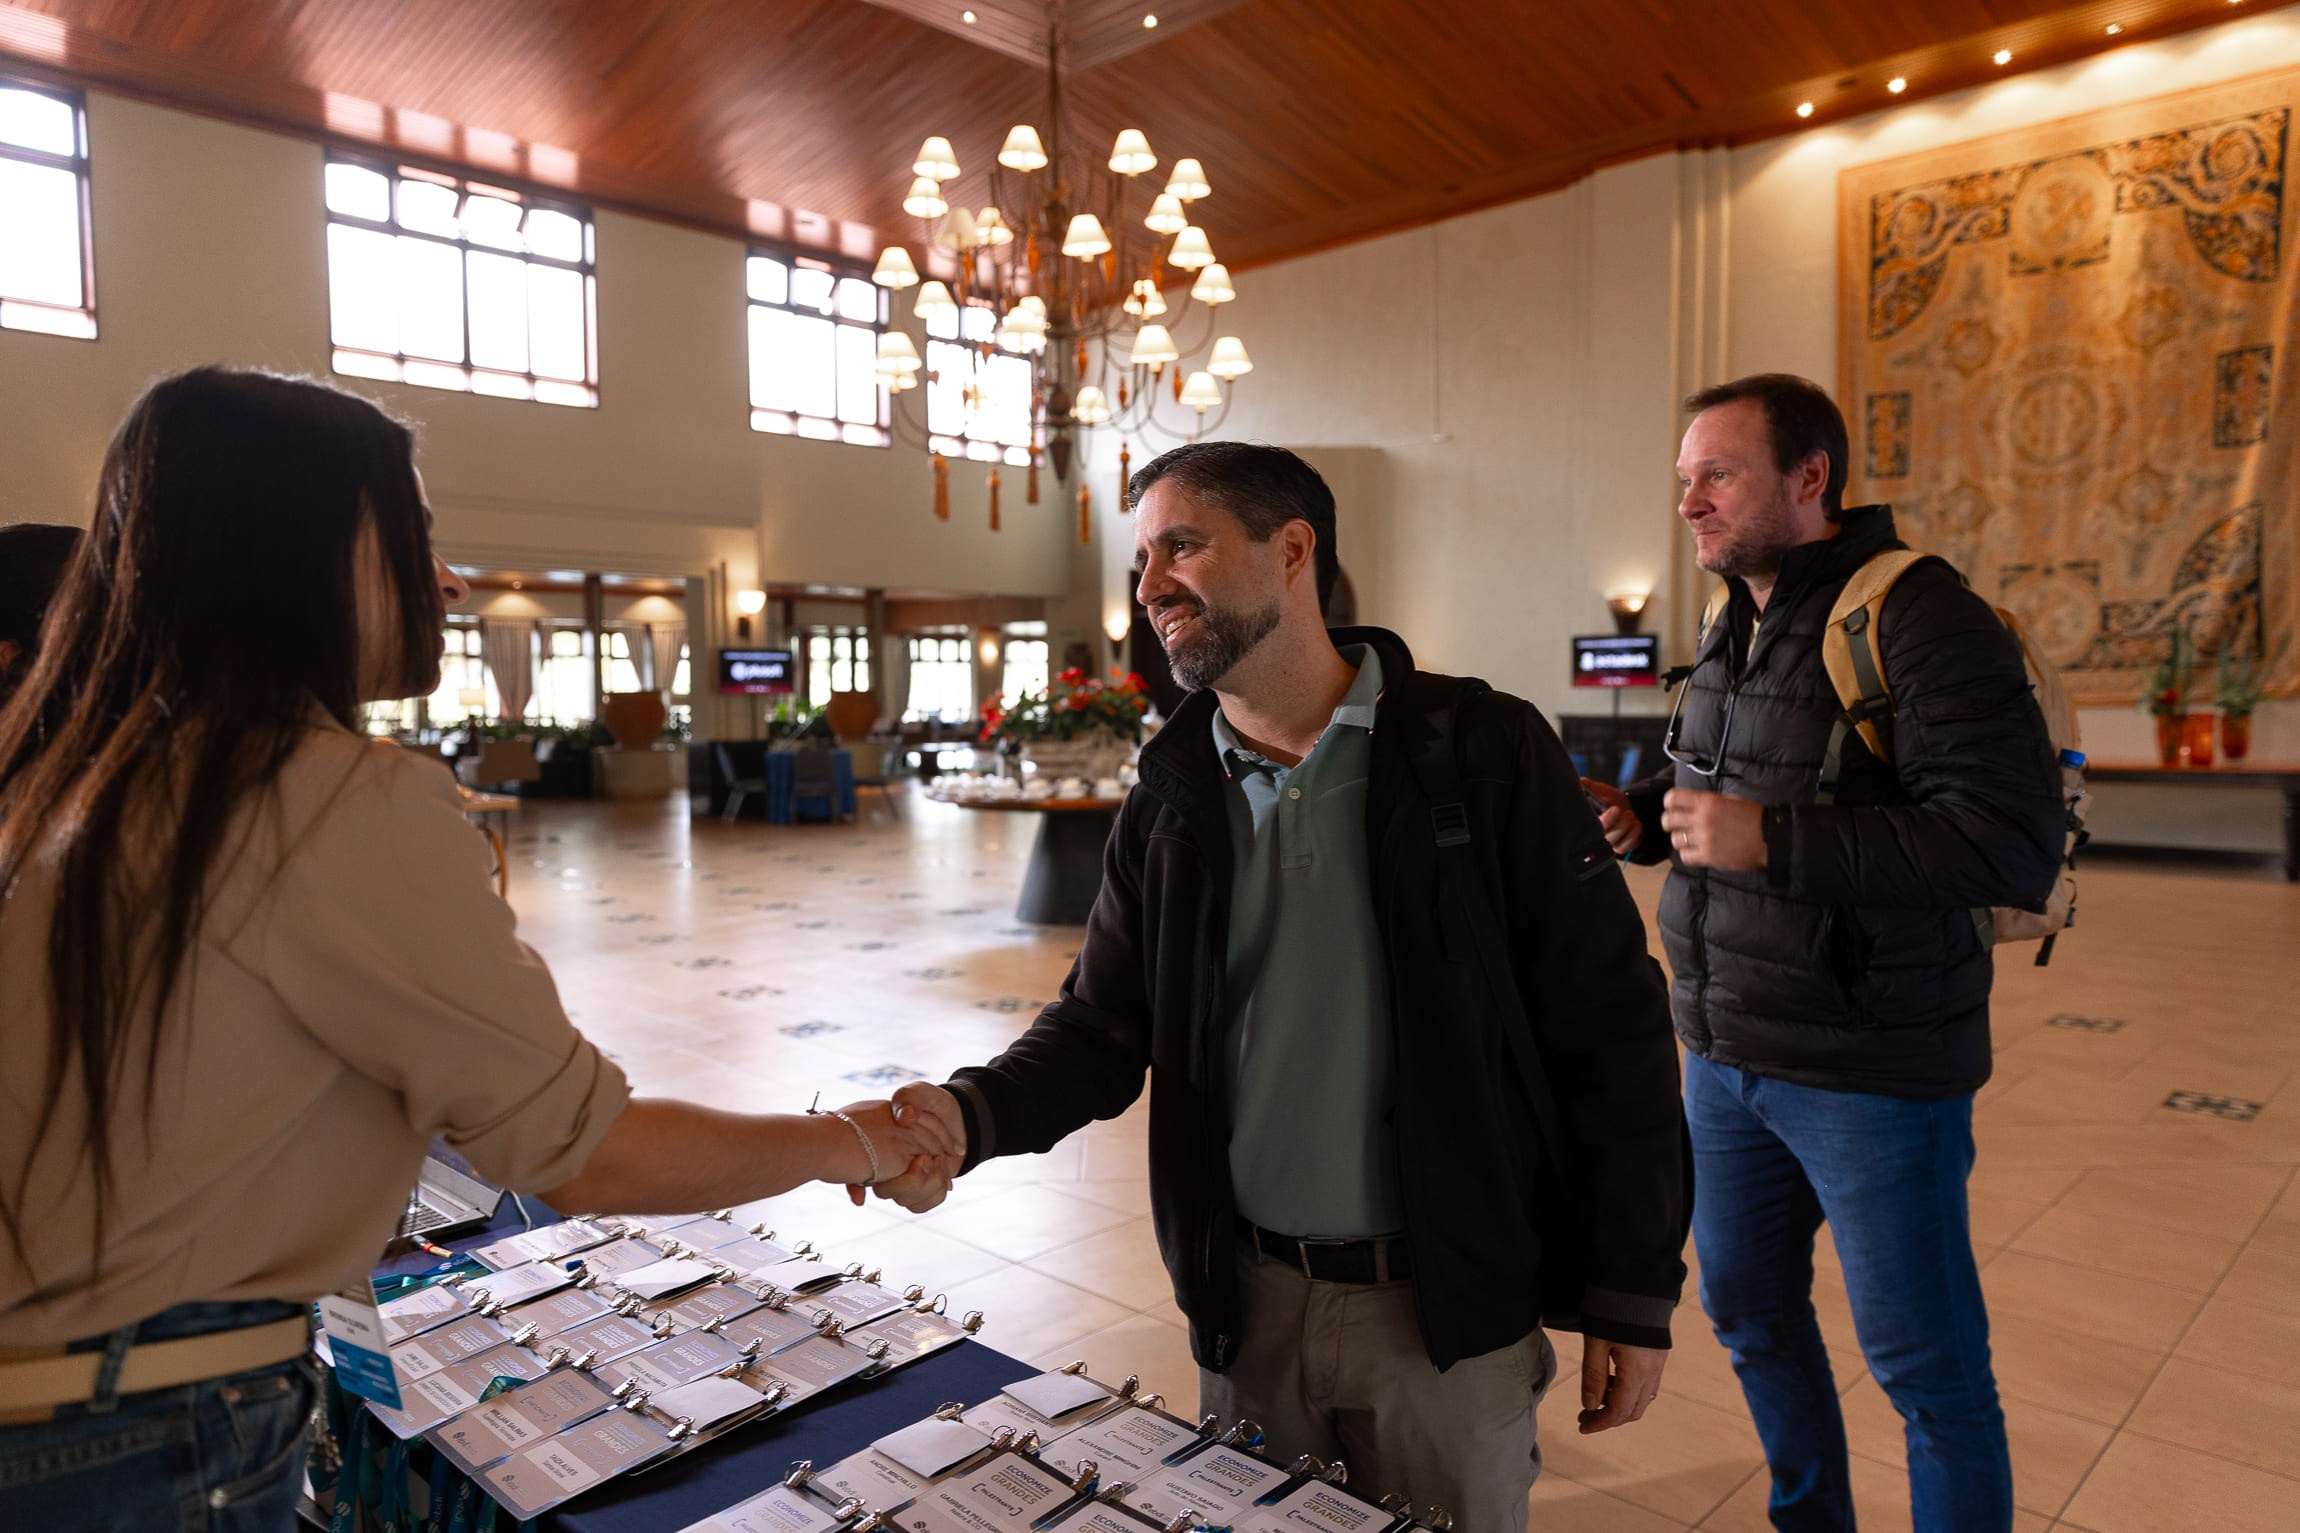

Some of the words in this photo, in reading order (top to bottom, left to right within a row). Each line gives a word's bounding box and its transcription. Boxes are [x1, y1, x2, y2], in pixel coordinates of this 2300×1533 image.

[673, 1347, 705, 1367] GRANDES
[1120, 1424, 1166, 1447] GRANDES
[1133, 1416, 1179, 1439] ECONOMIZE
[593, 1430, 630, 1455] GRANDES
[1077, 1438, 1114, 1457] ALEXANDRE
[1006, 1464, 1053, 1495] ECONOMIZE
[1204, 1462, 1256, 1488] GRANDES
[1217, 1455, 1269, 1480] ECONOMIZE
[991, 1474, 1038, 1505] GRANDES
[1166, 1482, 1199, 1500] GUSTAVO
[1197, 1473, 1235, 1493] PALESTRANTE
[940, 1493, 971, 1515] GABRIELA
[980, 1488, 1014, 1511] PALESTRANTE
[1315, 1491, 1372, 1521] ECONOMIZE
[773, 1499, 815, 1525] ECONOMIZE
[1302, 1501, 1359, 1531] GRANDES
